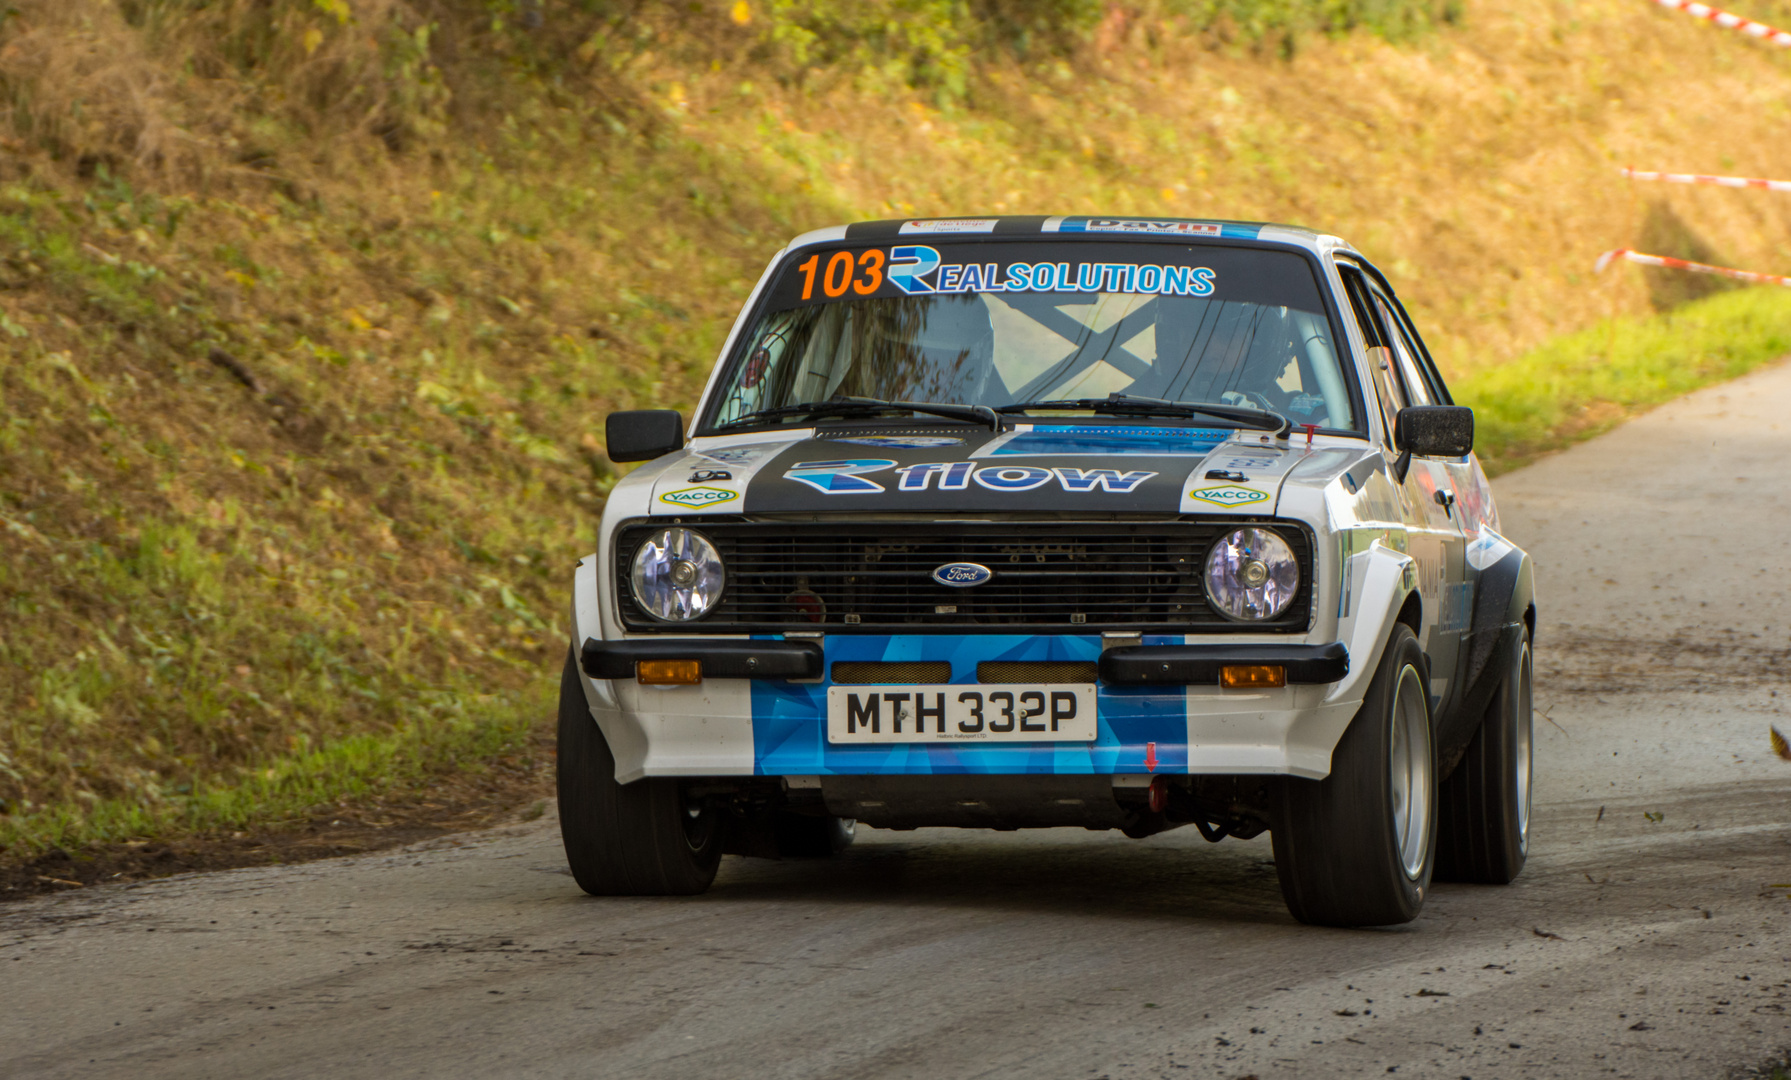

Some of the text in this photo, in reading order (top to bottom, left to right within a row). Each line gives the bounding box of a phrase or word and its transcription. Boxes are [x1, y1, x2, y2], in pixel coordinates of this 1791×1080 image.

[1089, 220, 1218, 232] Davin
[799, 249, 885, 300] 103
[671, 491, 730, 501] YACCO
[1201, 490, 1261, 500] YACCO
[946, 566, 978, 580] Ford
[847, 691, 1077, 733] MTH 332P
